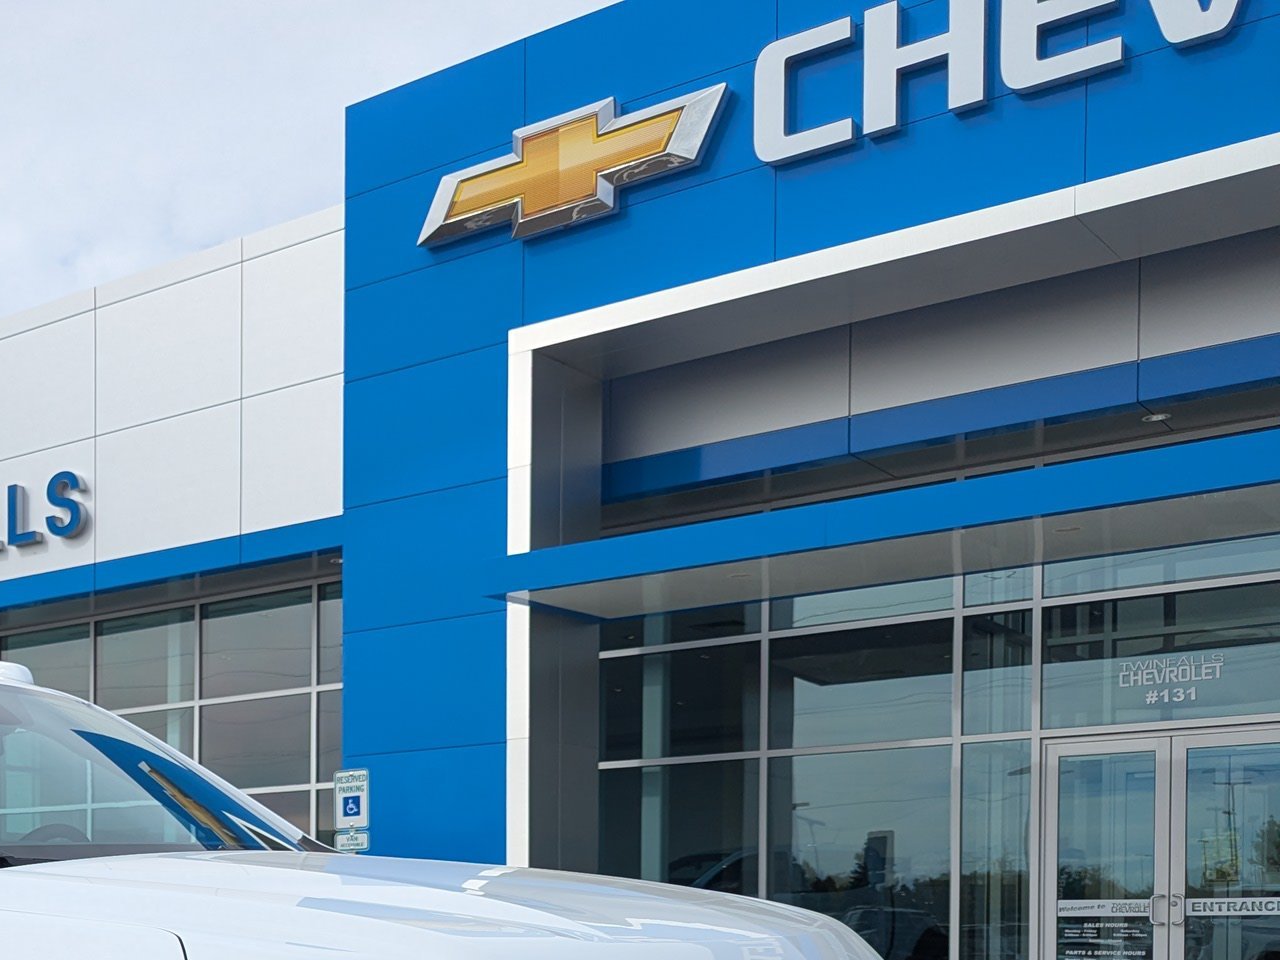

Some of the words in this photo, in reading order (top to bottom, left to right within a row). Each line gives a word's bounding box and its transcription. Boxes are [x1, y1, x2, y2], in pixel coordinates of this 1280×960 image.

[1119, 662, 1224, 688] CHEVROLET
[1145, 686, 1197, 705] #131
[336, 774, 366, 784] RESERVED
[338, 785, 365, 794] PARKING
[1059, 904, 1095, 912] Welcome
